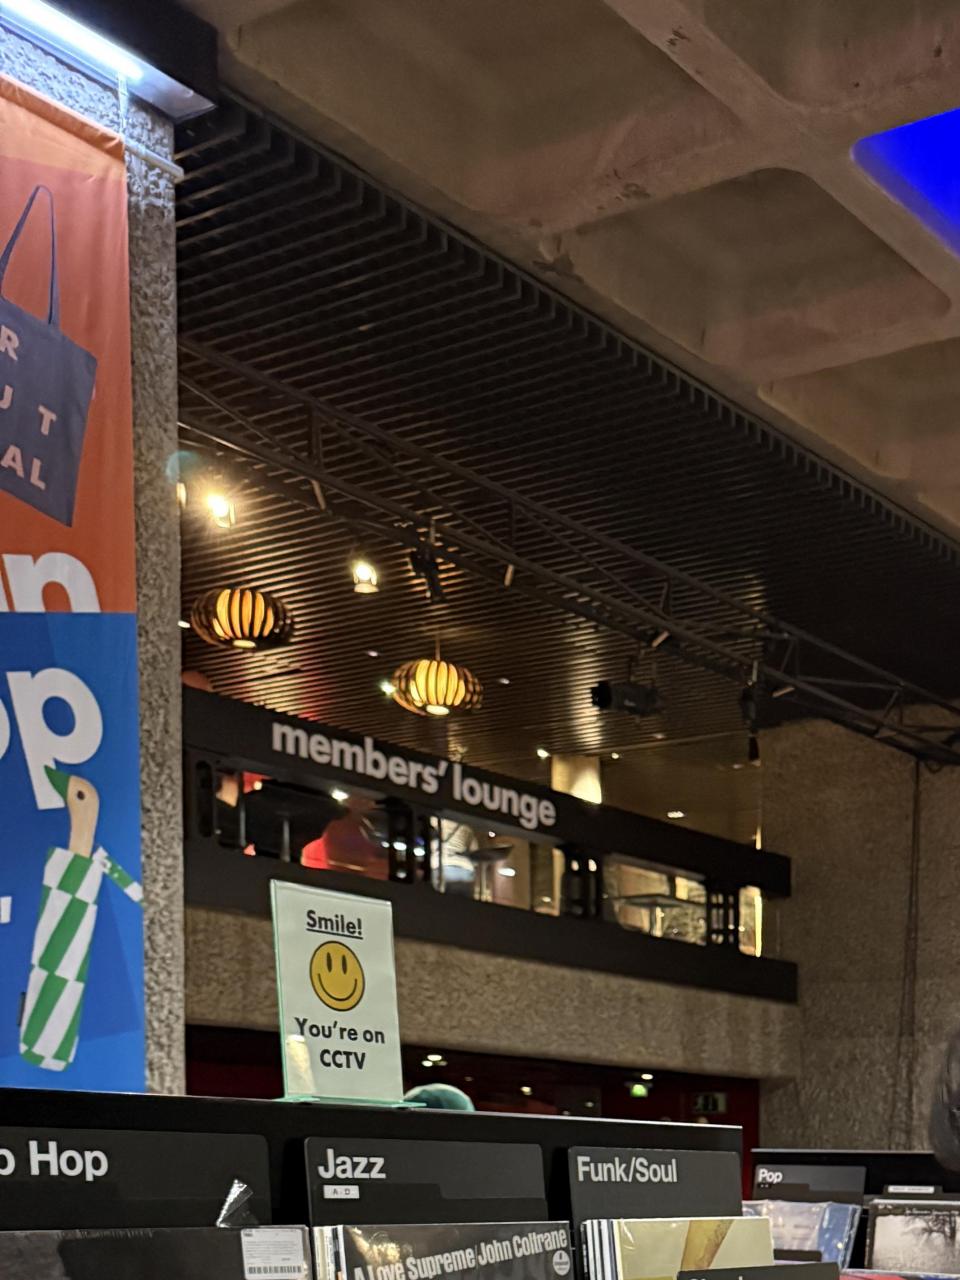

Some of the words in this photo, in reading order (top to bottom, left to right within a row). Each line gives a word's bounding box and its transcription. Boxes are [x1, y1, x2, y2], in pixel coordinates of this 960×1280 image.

[453, 764, 556, 830] lounge
[305, 909, 363, 937] Smile!
[363, 1027, 386, 1044] on
[319, 1048, 366, 1071] CCTV
[29, 1140, 109, 1182] Hop
[317, 1148, 387, 1179] Jazz
[577, 1156, 678, 1183] Funk/Soul
[758, 1168, 783, 1184] Pop
[511, 1228, 568, 1259] Coltrane
